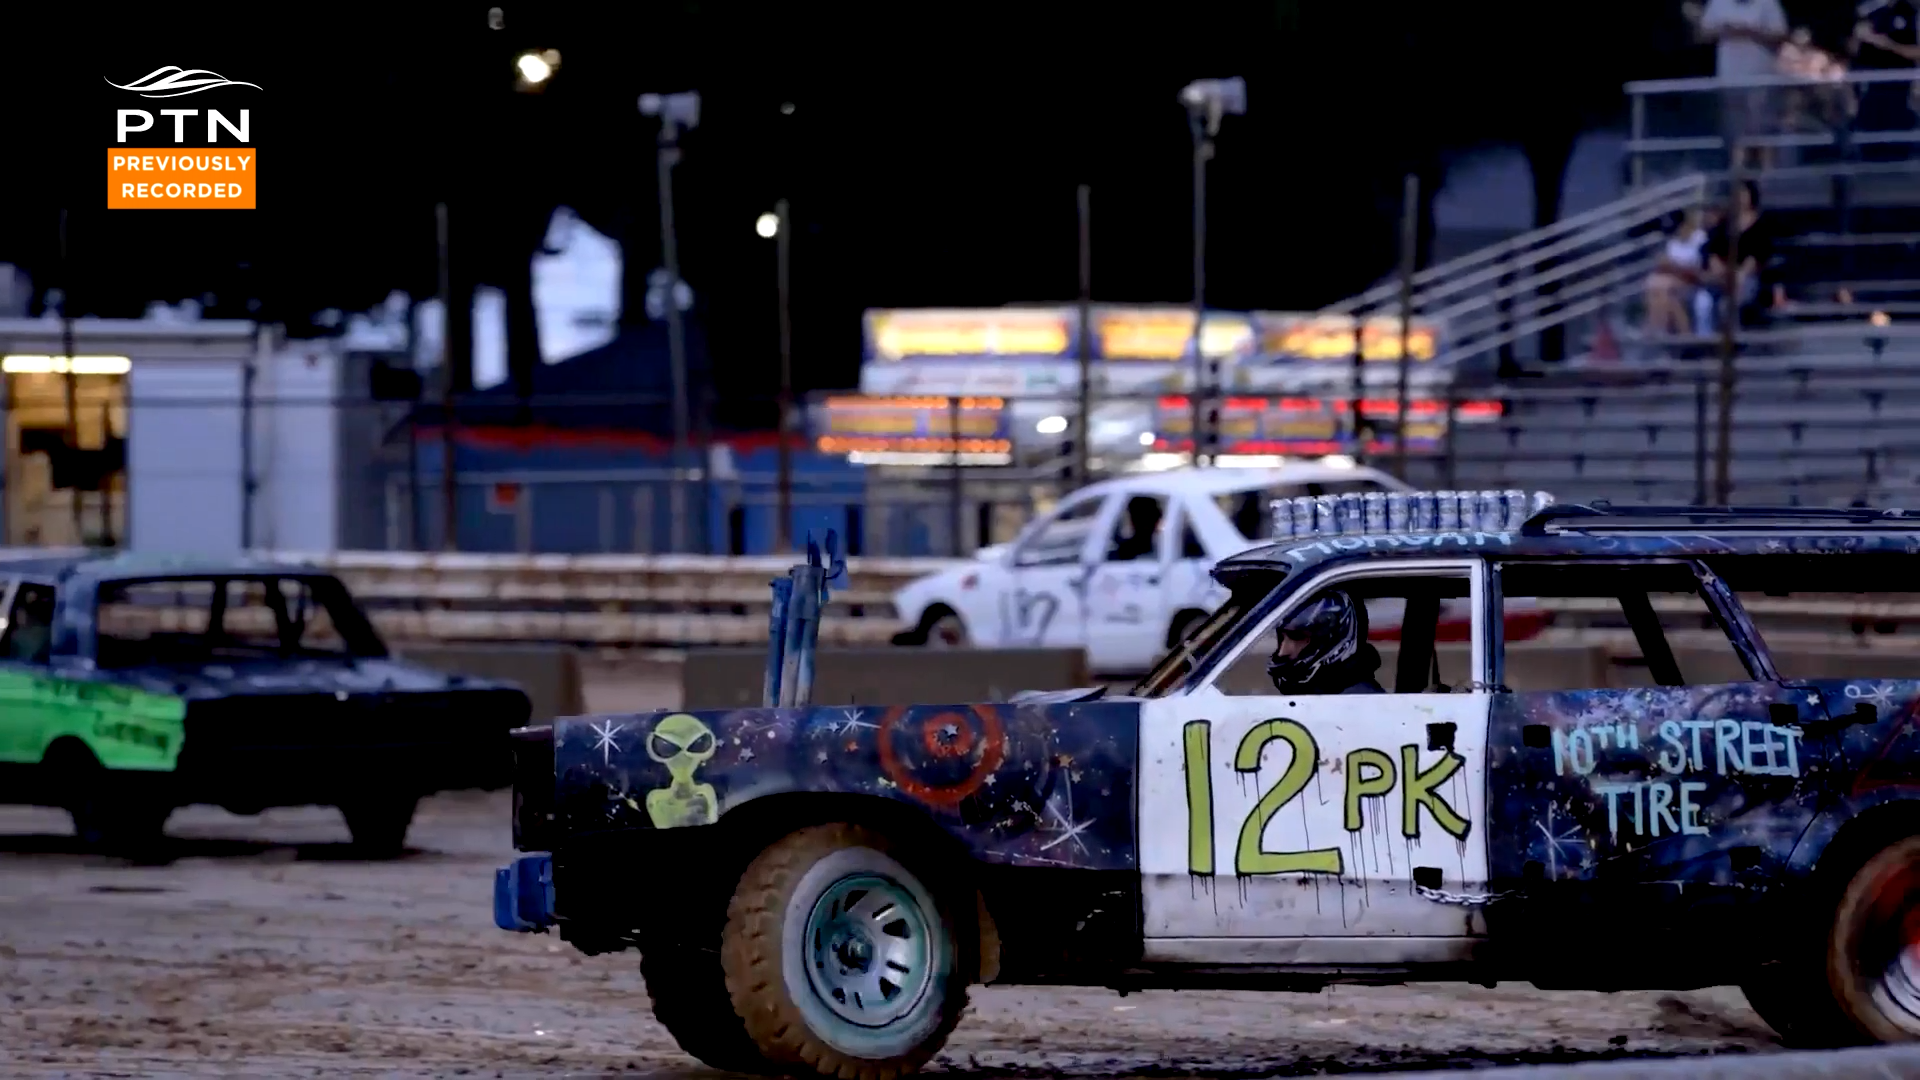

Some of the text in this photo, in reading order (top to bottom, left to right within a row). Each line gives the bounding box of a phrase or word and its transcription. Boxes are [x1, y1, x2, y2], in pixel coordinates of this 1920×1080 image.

[1552, 718, 1804, 778] 10TH STREET
[1594, 781, 1710, 838] TIRE
